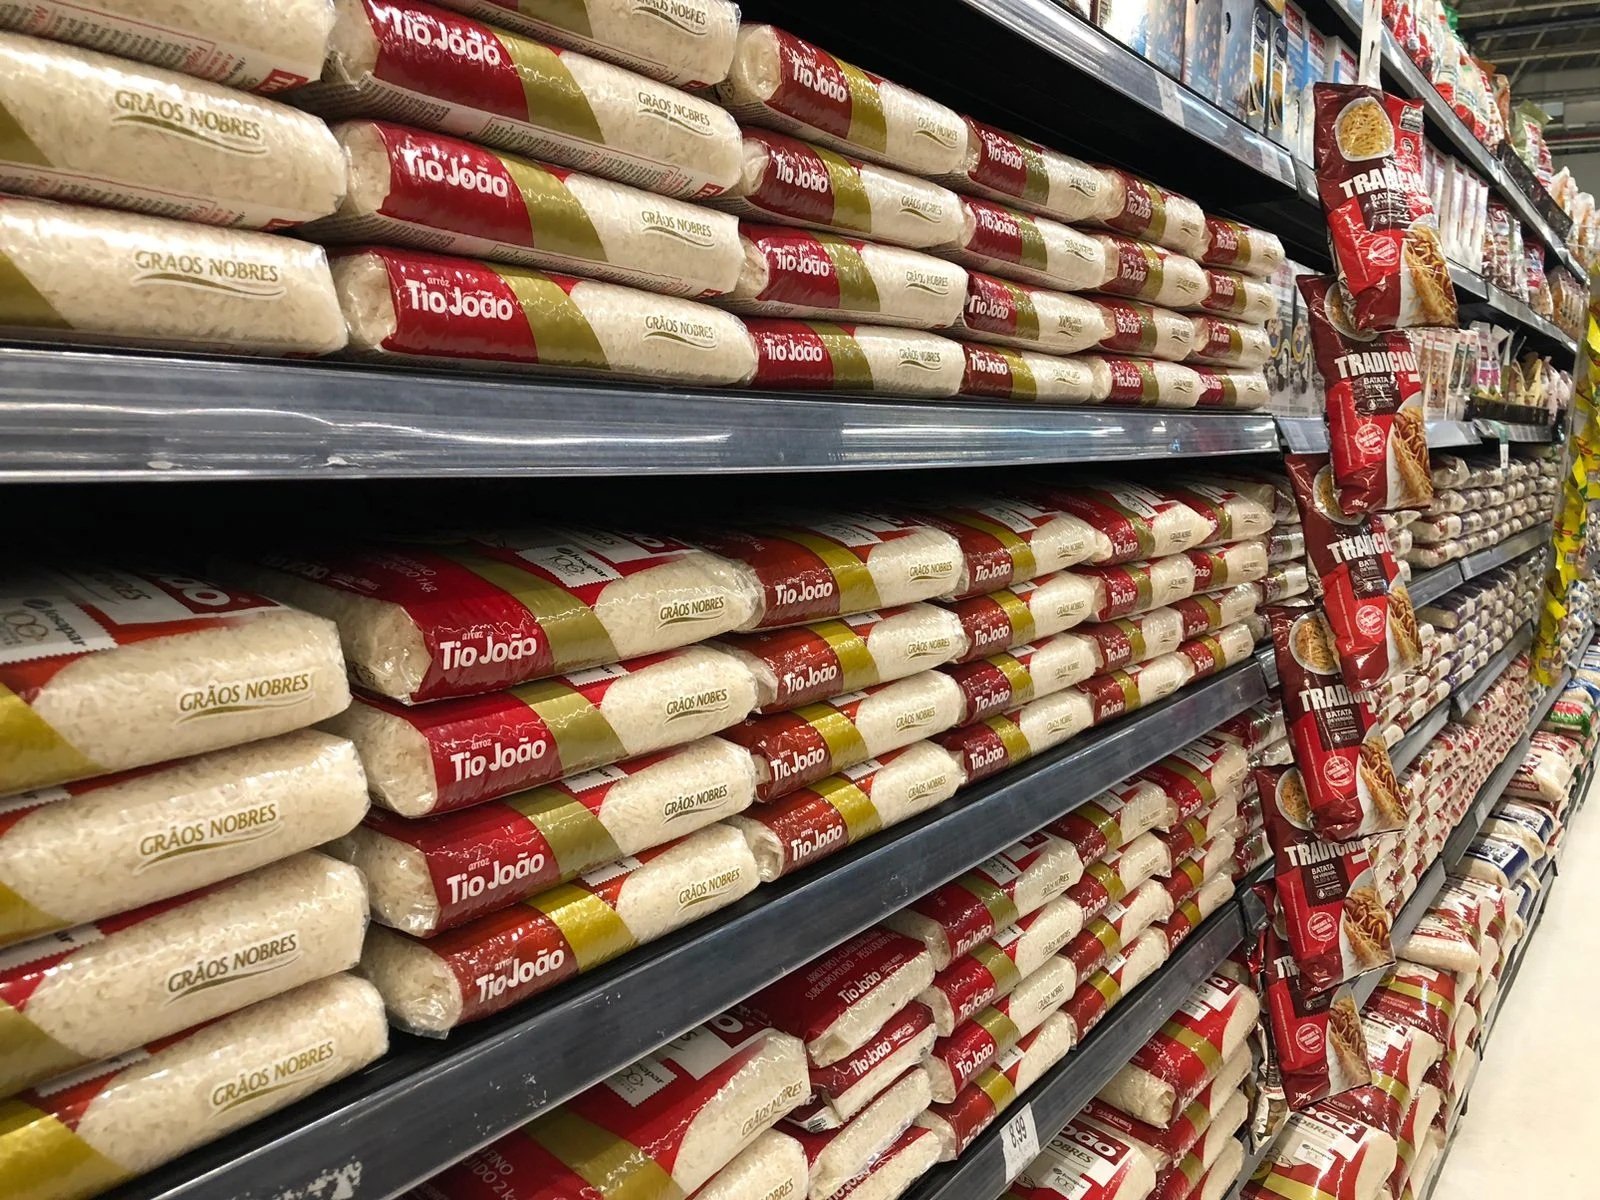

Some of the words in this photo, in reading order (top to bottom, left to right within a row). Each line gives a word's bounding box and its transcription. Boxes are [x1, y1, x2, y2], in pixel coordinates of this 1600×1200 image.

[671, 0, 705, 25] NOBRES
[115, 90, 184, 122] GRÃOS
[190, 108, 261, 140] NOBRES
[447, 167, 509, 197] João
[641, 211, 674, 227] GRÃOS
[677, 215, 712, 238] NOBRES
[209, 259, 278, 281] NOBRES
[776, 248, 797, 270] Tio
[797, 254, 830, 277] João
[427, 276, 450, 287] arroz
[405, 279, 446, 311] Tio
[448, 288, 513, 321] João
[969, 295, 987, 315] Tio
[645, 316, 678, 331] GRÃOS
[680, 322, 714, 339] NOBRES
[765, 339, 787, 361] Tio
[788, 340, 823, 362] João
[1364, 377, 1389, 385] BATATA
[909, 563, 929, 577] GRÃOS
[931, 561, 953, 574] NOBRES
[975, 565, 989, 582] Tio
[989, 559, 1011, 578] João
[775, 584, 797, 606] Tio
[798, 579, 833, 603] João
[660, 602, 689, 621] GRÃOS
[691, 596, 724, 615] NOBRES
[975, 629, 988, 646] Tio
[988, 623, 1009, 642] João
[439, 639, 478, 671] Tio
[479, 633, 537, 665] João
[784, 673, 805, 695] Tio
[805, 663, 837, 688] João
[180, 684, 241, 712] GRÃOS
[245, 673, 309, 701] NOBRES
[667, 696, 695, 715] GRÃOS
[975, 696, 988, 712] Tio
[988, 688, 1010, 707] João
[916, 707, 935, 722] NOBRES
[1325, 709, 1353, 719] BATATA
[470, 738, 492, 751] arroz
[970, 752, 983, 770] Tio
[985, 745, 1004, 764] João
[451, 752, 487, 783] Tio
[489, 737, 546, 772] João
[770, 758, 791, 781] Tio
[791, 746, 825, 774] João
[664, 796, 694, 817] GRÃOS
[696, 784, 728, 805] NOBRES
[140, 824, 205, 857] GRÃOS
[209, 803, 278, 839] NOBRES
[791, 838, 810, 861] Tio
[812, 823, 843, 851] João
[468, 857, 491, 872] arroz
[1311, 863, 1335, 874] BATATA
[446, 872, 484, 905] Tio
[488, 851, 545, 891] João
[679, 882, 707, 905] GRÃOS
[708, 868, 741, 894] NOBRES
[956, 938, 972, 956] Tio
[168, 956, 229, 994] GRÃOS
[232, 933, 297, 971] NOBRES
[475, 975, 507, 1004] Tio
[508, 946, 565, 988] João
[837, 990, 860, 1004] Tio
[854, 971, 880, 993] João
[850, 1057, 870, 1077] Tio
[955, 1059, 972, 1079] Tio
[973, 1042, 994, 1068] João
[212, 1073, 269, 1107] GRÃOS
[274, 1041, 334, 1083] NOBRES
